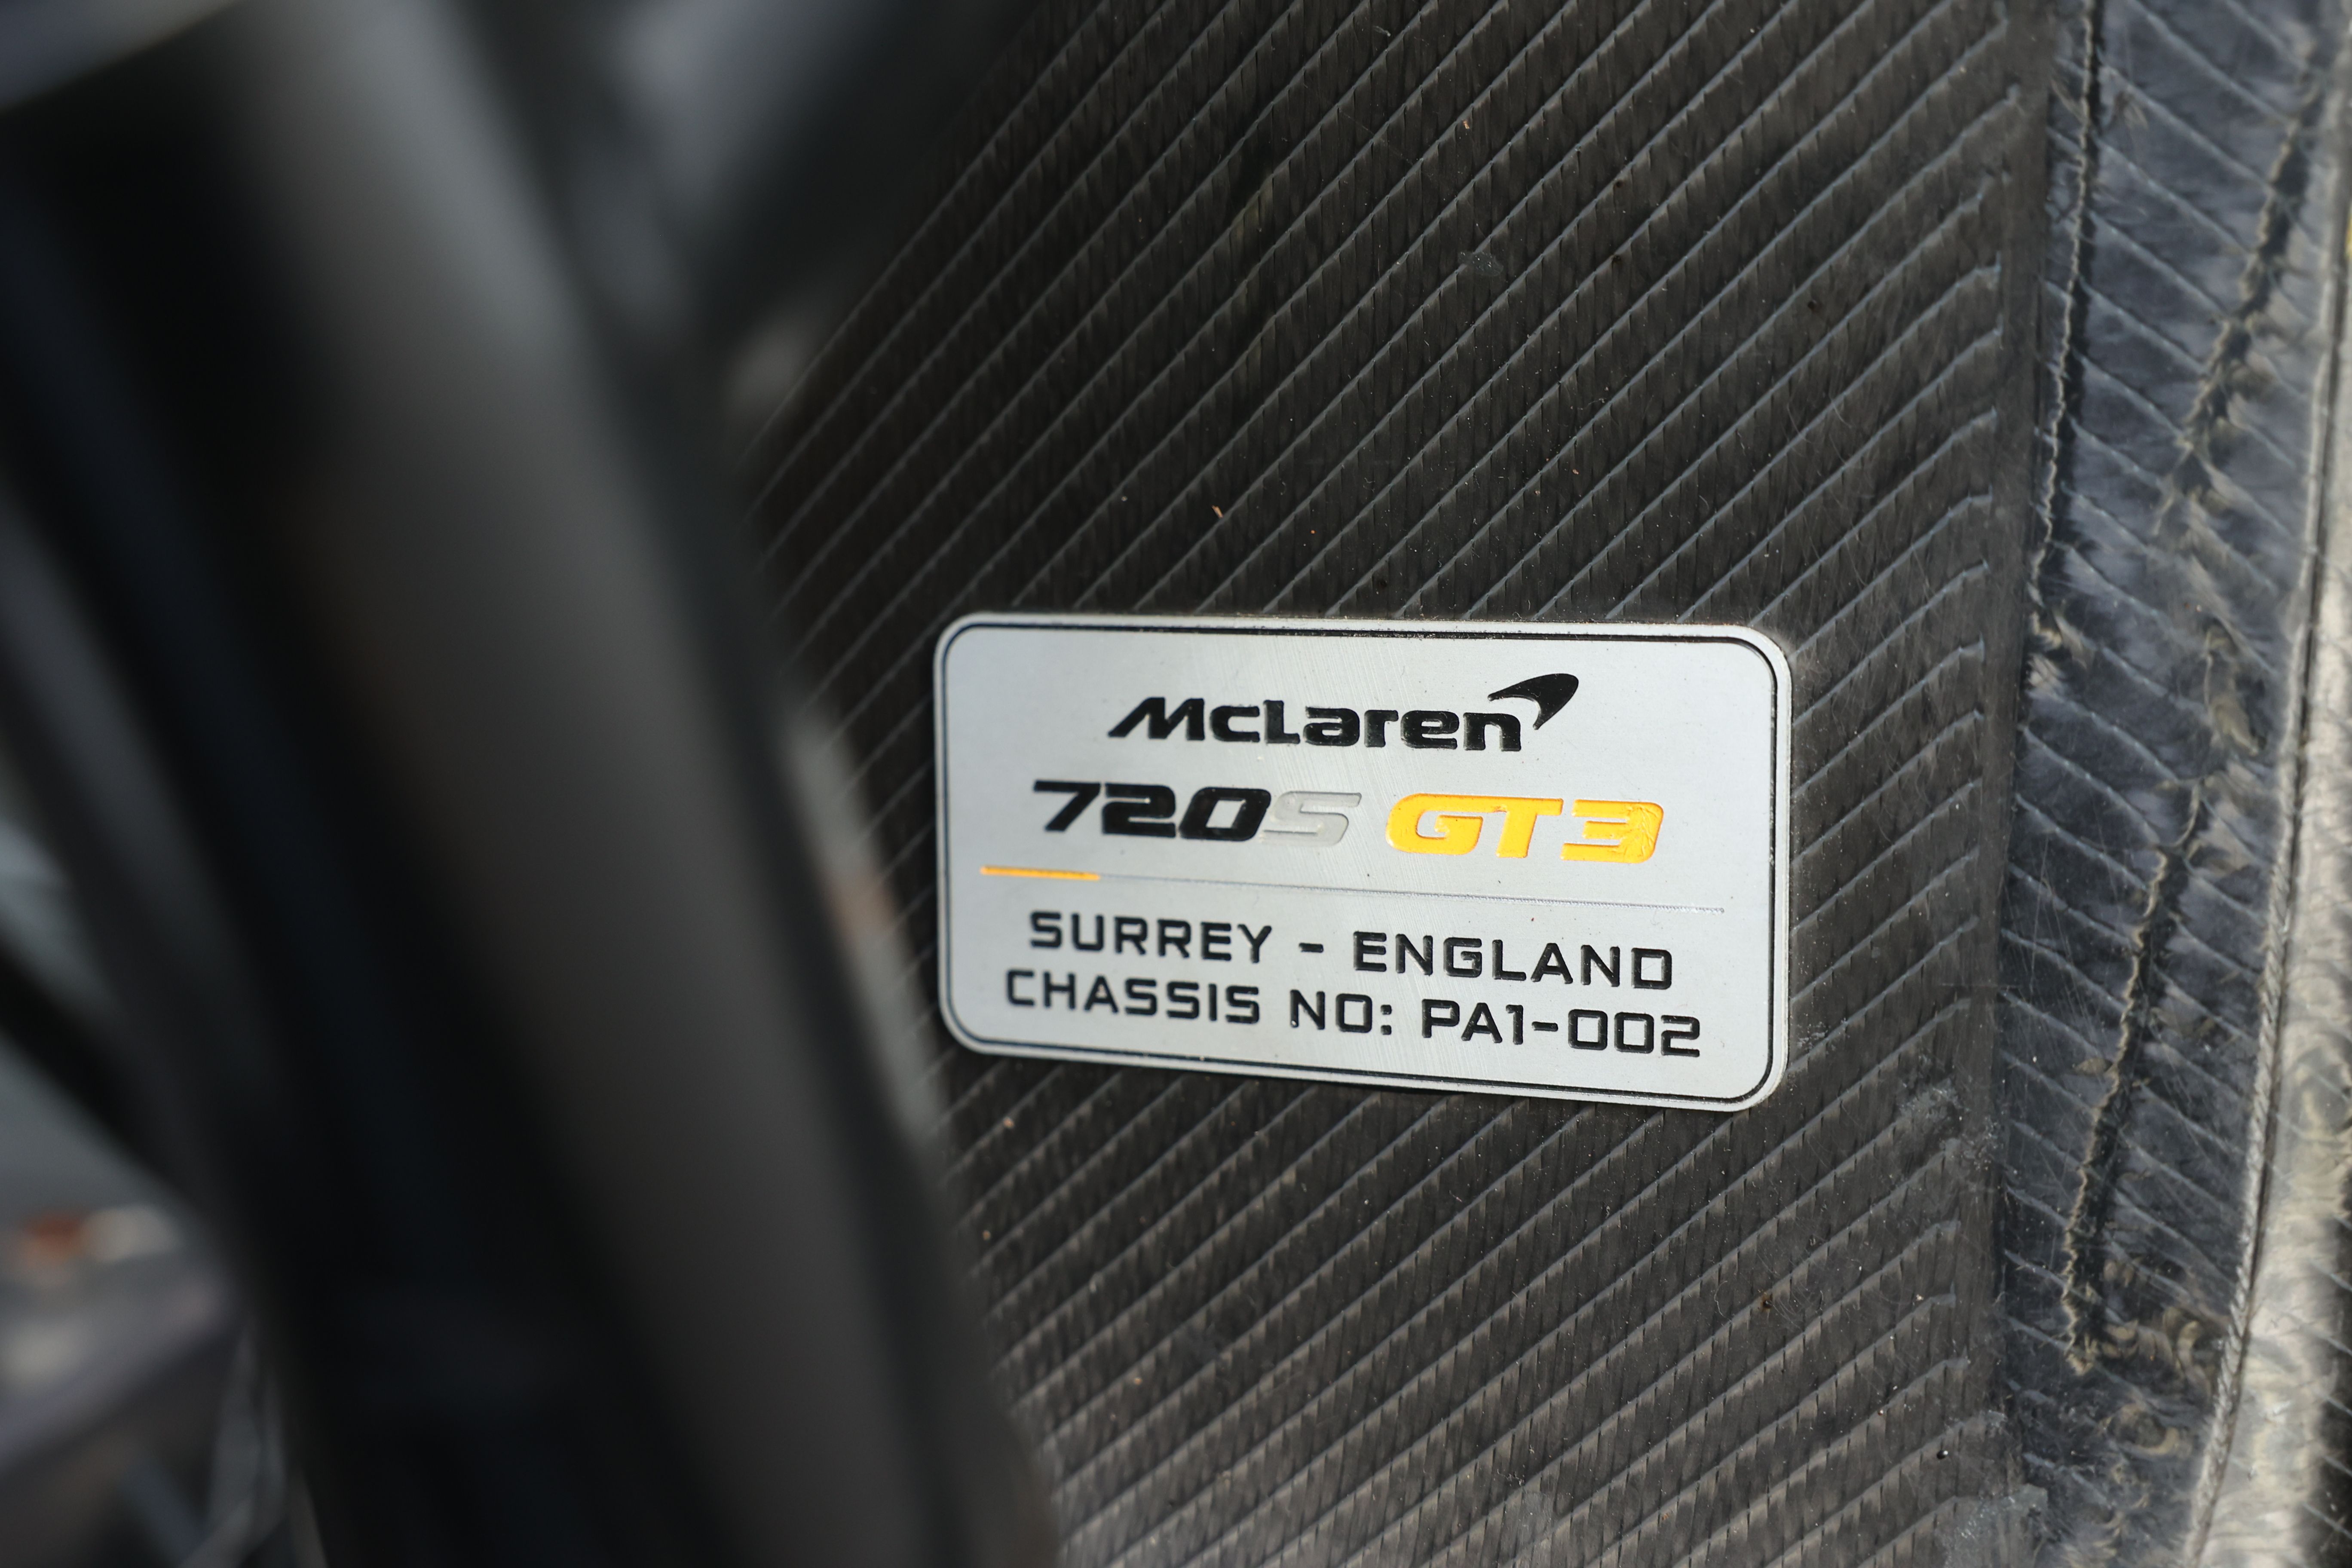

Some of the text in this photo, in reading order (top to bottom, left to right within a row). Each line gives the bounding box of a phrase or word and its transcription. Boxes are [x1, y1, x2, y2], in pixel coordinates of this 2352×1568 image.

[1107, 696, 1522, 753] McLaren
[1032, 779, 1665, 864] 720S GT3
[1029, 910, 1273, 964] SURREY
[1353, 930, 1673, 990] ENGLAND
[1006, 969, 1700, 1058] CHASSIS NO: PA1-002
